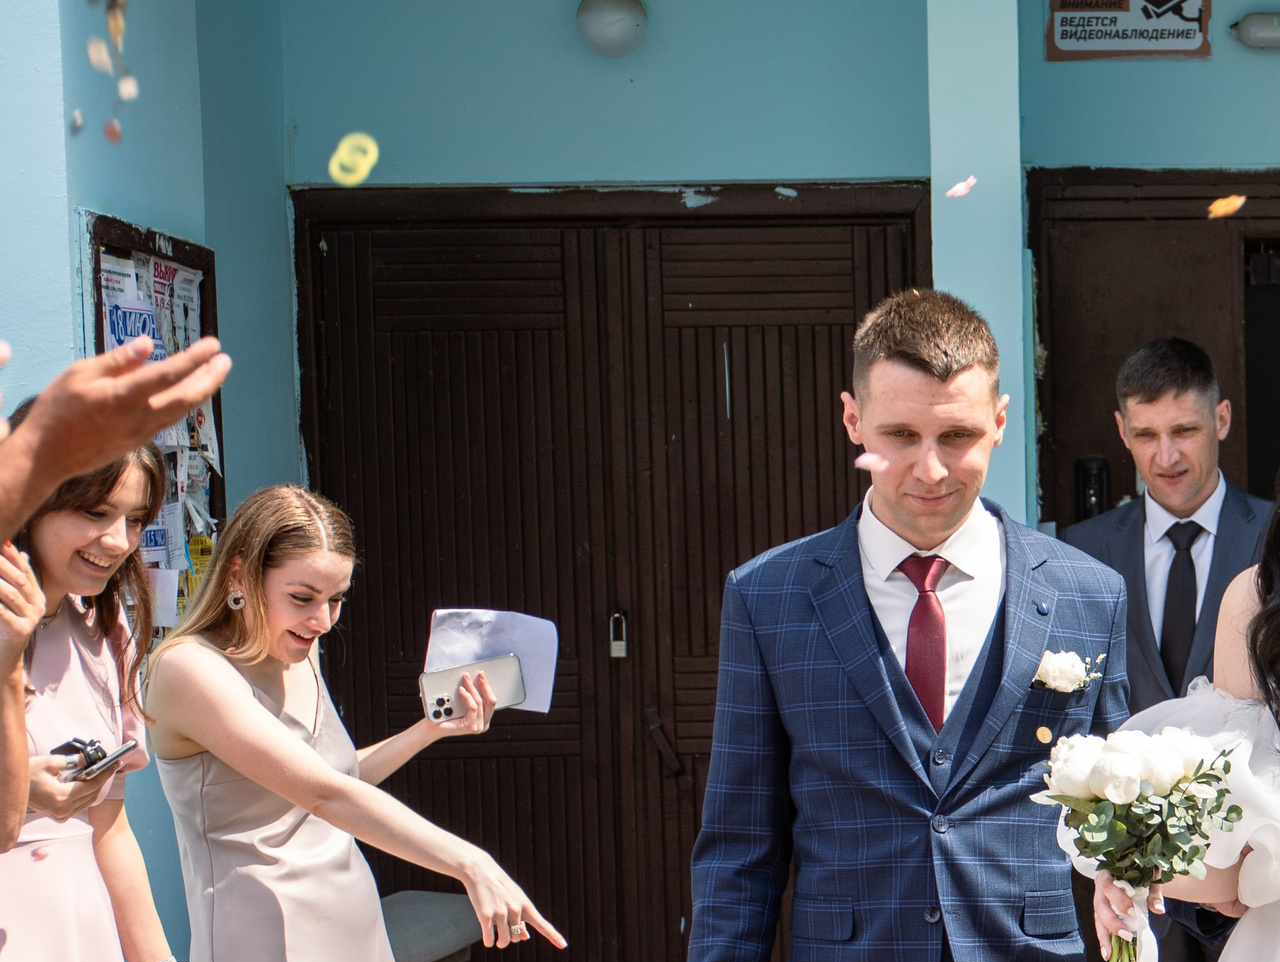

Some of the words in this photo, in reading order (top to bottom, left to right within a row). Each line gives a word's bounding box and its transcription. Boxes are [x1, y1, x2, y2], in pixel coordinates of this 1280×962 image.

[1059, 0, 1124, 9] ВНИМАНИЕ
[1060, 17, 1118, 28] ВЕДЕТСЯ
[1060, 29, 1197, 41] ВИДЕОНАБЛЮДЕНИЕ!
[112, 308, 125, 341] 18
